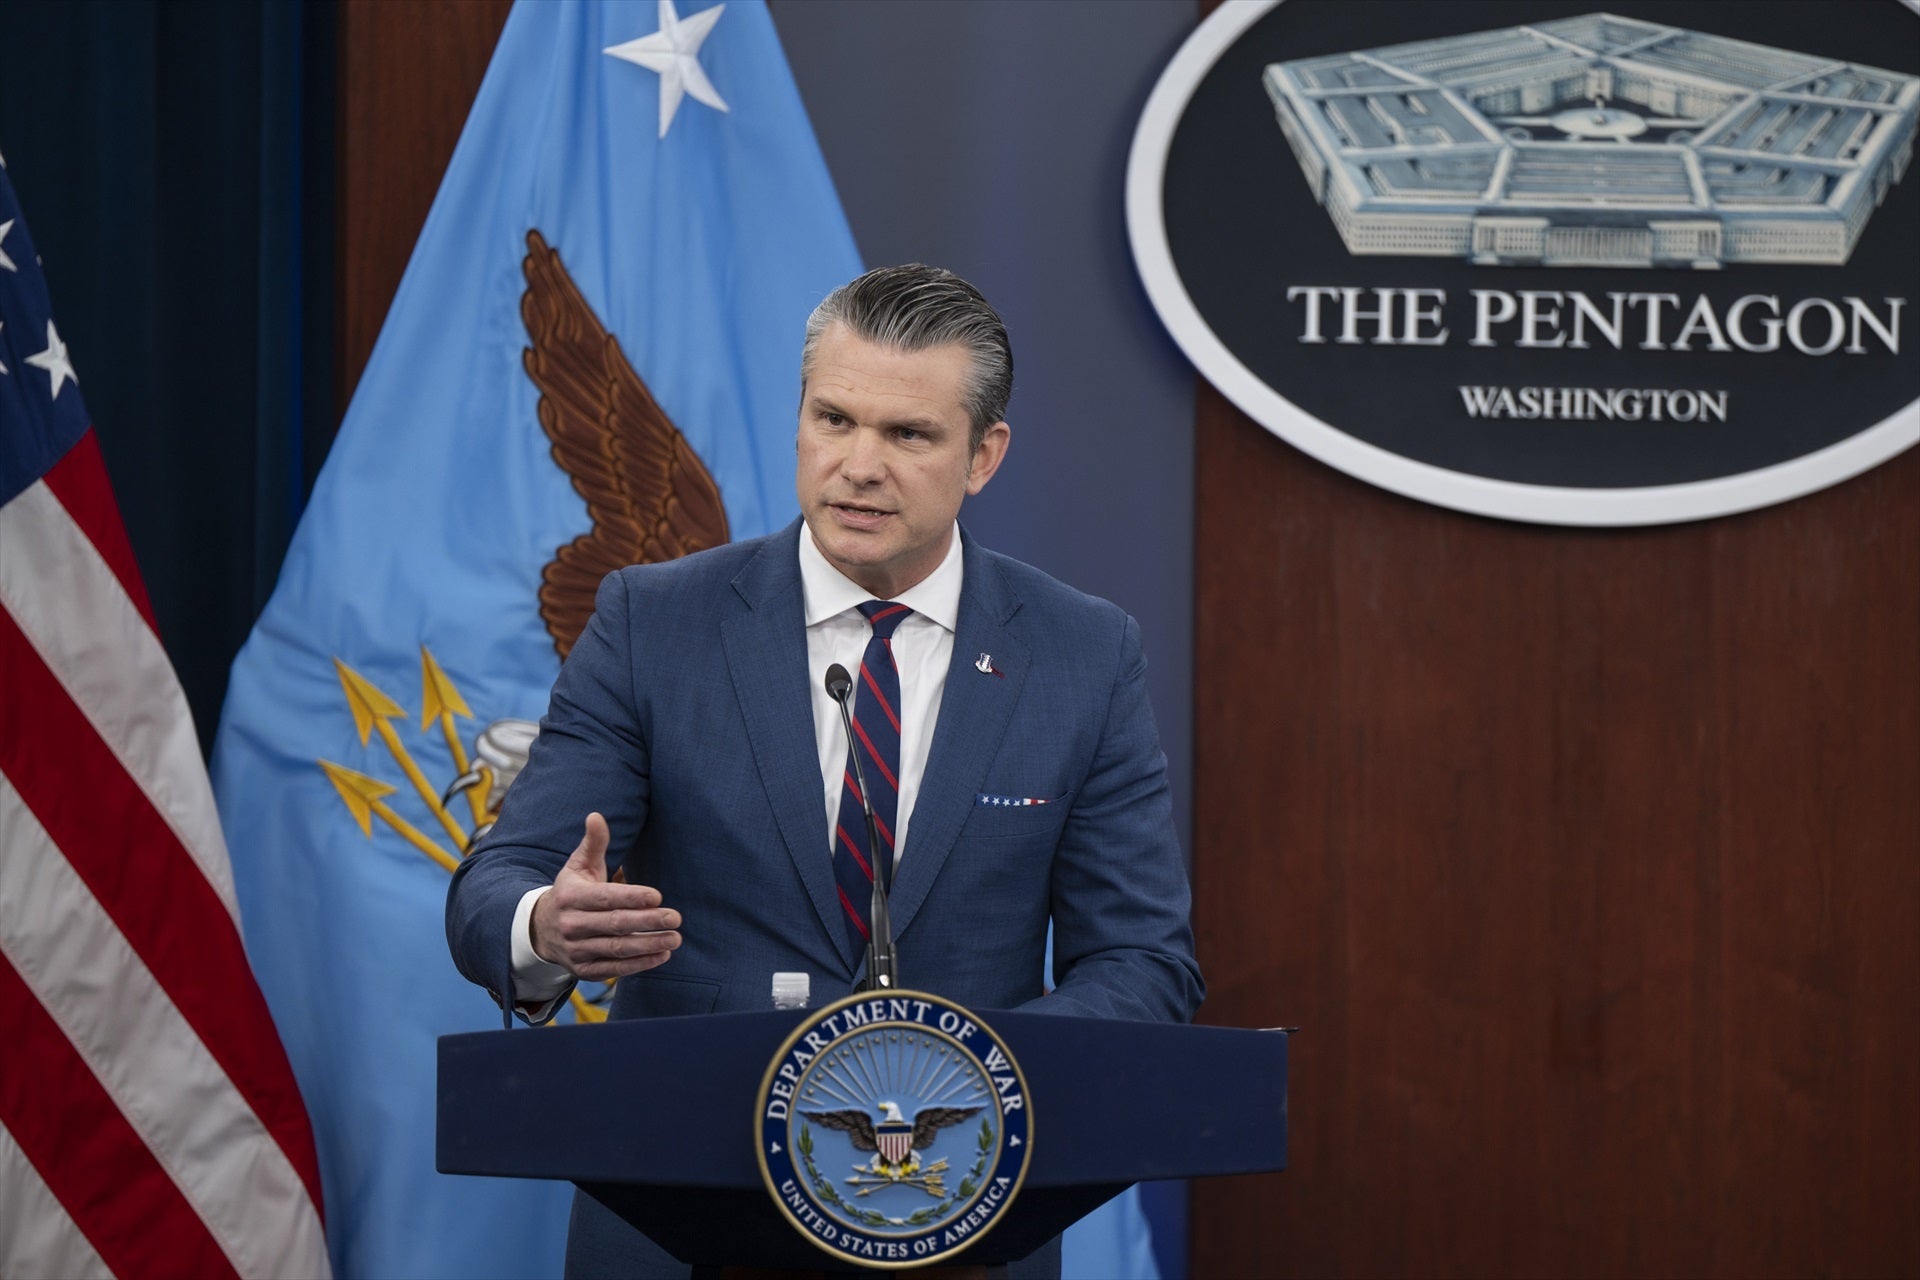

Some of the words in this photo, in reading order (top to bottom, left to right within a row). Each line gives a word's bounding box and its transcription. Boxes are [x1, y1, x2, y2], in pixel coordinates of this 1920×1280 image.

[1287, 285, 1450, 346] THE
[1467, 288, 1906, 356] PENTAGON
[1458, 384, 1729, 422] WASHINGTON
[767, 999, 932, 1121] DEPARTMENT
[939, 1011, 978, 1043] OF
[984, 1044, 1024, 1115] WAR
[781, 1178, 837, 1241] UNITED
[839, 1233, 908, 1258] STATES
[914, 1236, 941, 1256] OF
[944, 1175, 1011, 1246] AMERICA
